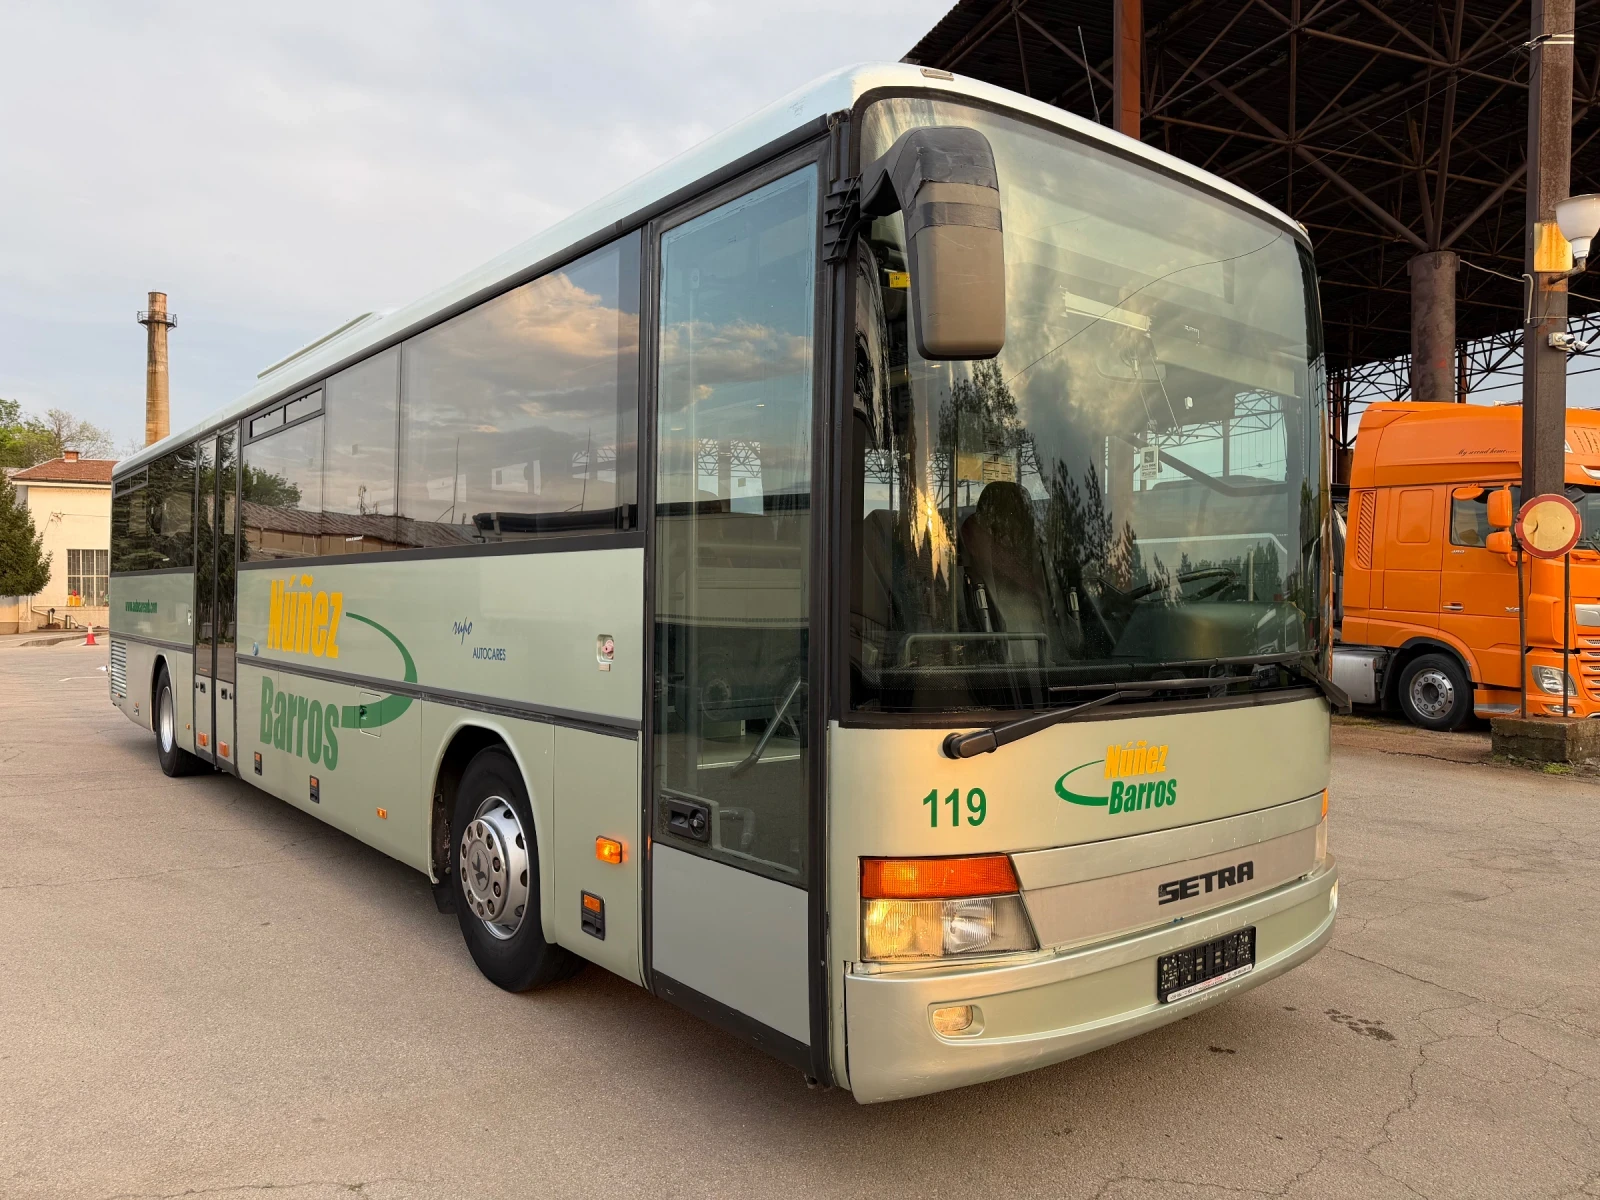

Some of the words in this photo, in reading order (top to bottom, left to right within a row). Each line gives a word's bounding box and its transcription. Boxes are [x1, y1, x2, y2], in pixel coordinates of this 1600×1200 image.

[267, 573, 343, 659] Núñez
[472, 647, 506, 661] AUTOCARES
[259, 675, 340, 771] Barros
[1103, 740, 1169, 780] Núñez
[922, 787, 987, 828] 119
[1108, 778, 1177, 815] Barros
[1158, 860, 1254, 906] SETRA
